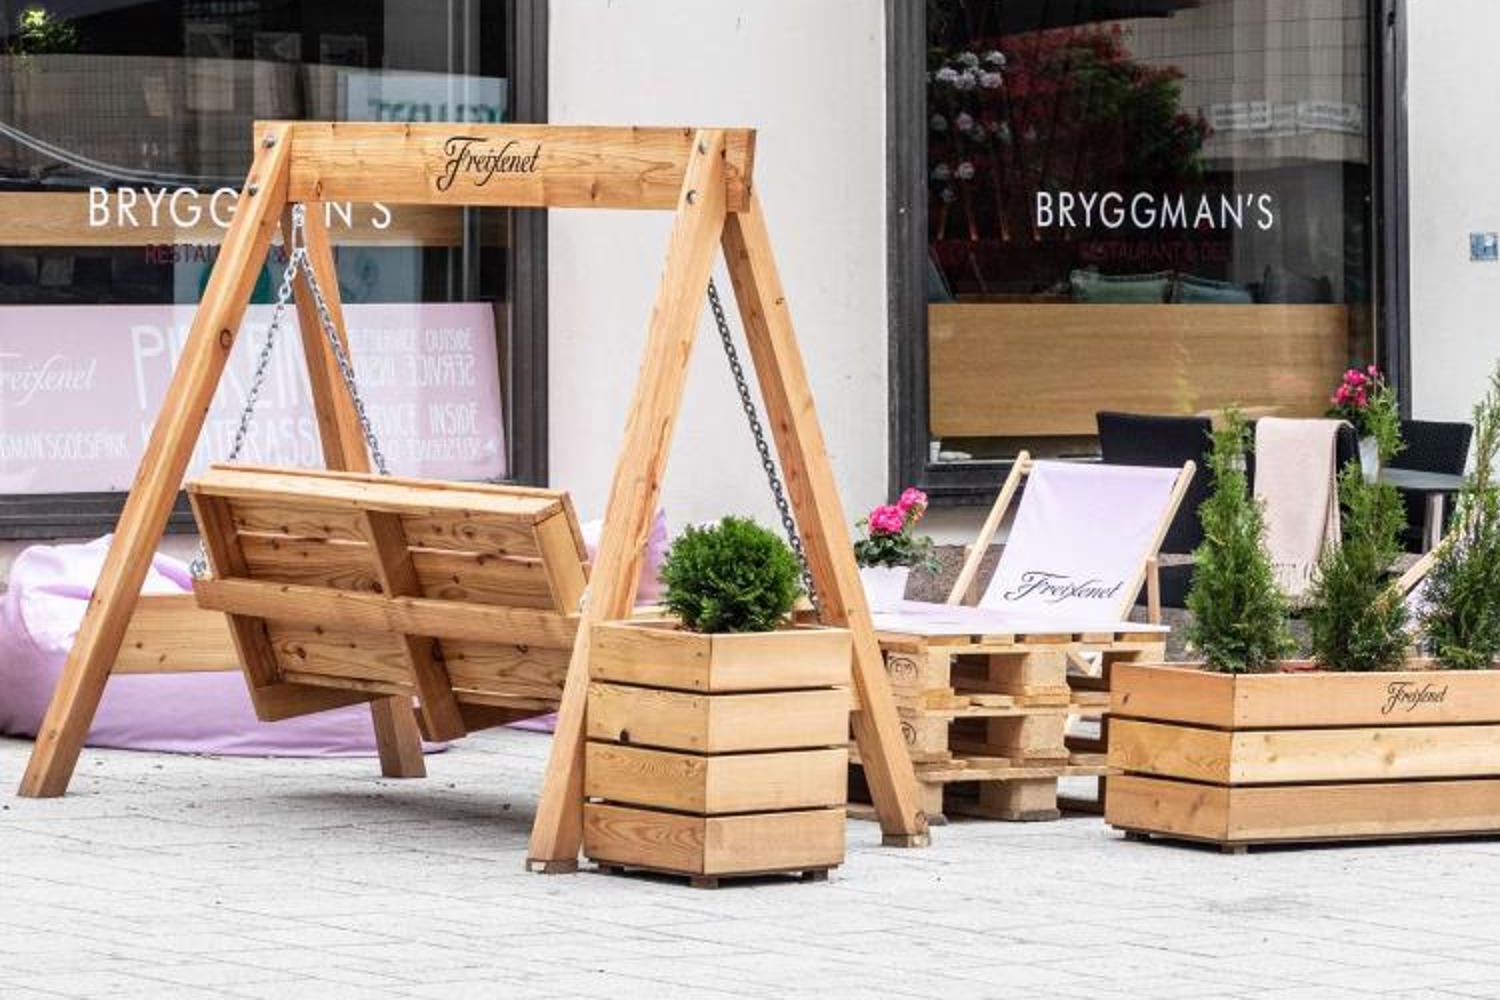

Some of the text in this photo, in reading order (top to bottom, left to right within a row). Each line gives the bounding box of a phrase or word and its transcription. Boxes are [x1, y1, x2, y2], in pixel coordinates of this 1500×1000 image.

[436, 135, 542, 192] Freixenet
[1035, 190, 1275, 231] BRYGGMAN'S
[1003, 571, 1125, 603] Freixenet
[1381, 681, 1450, 716] Freixenet
